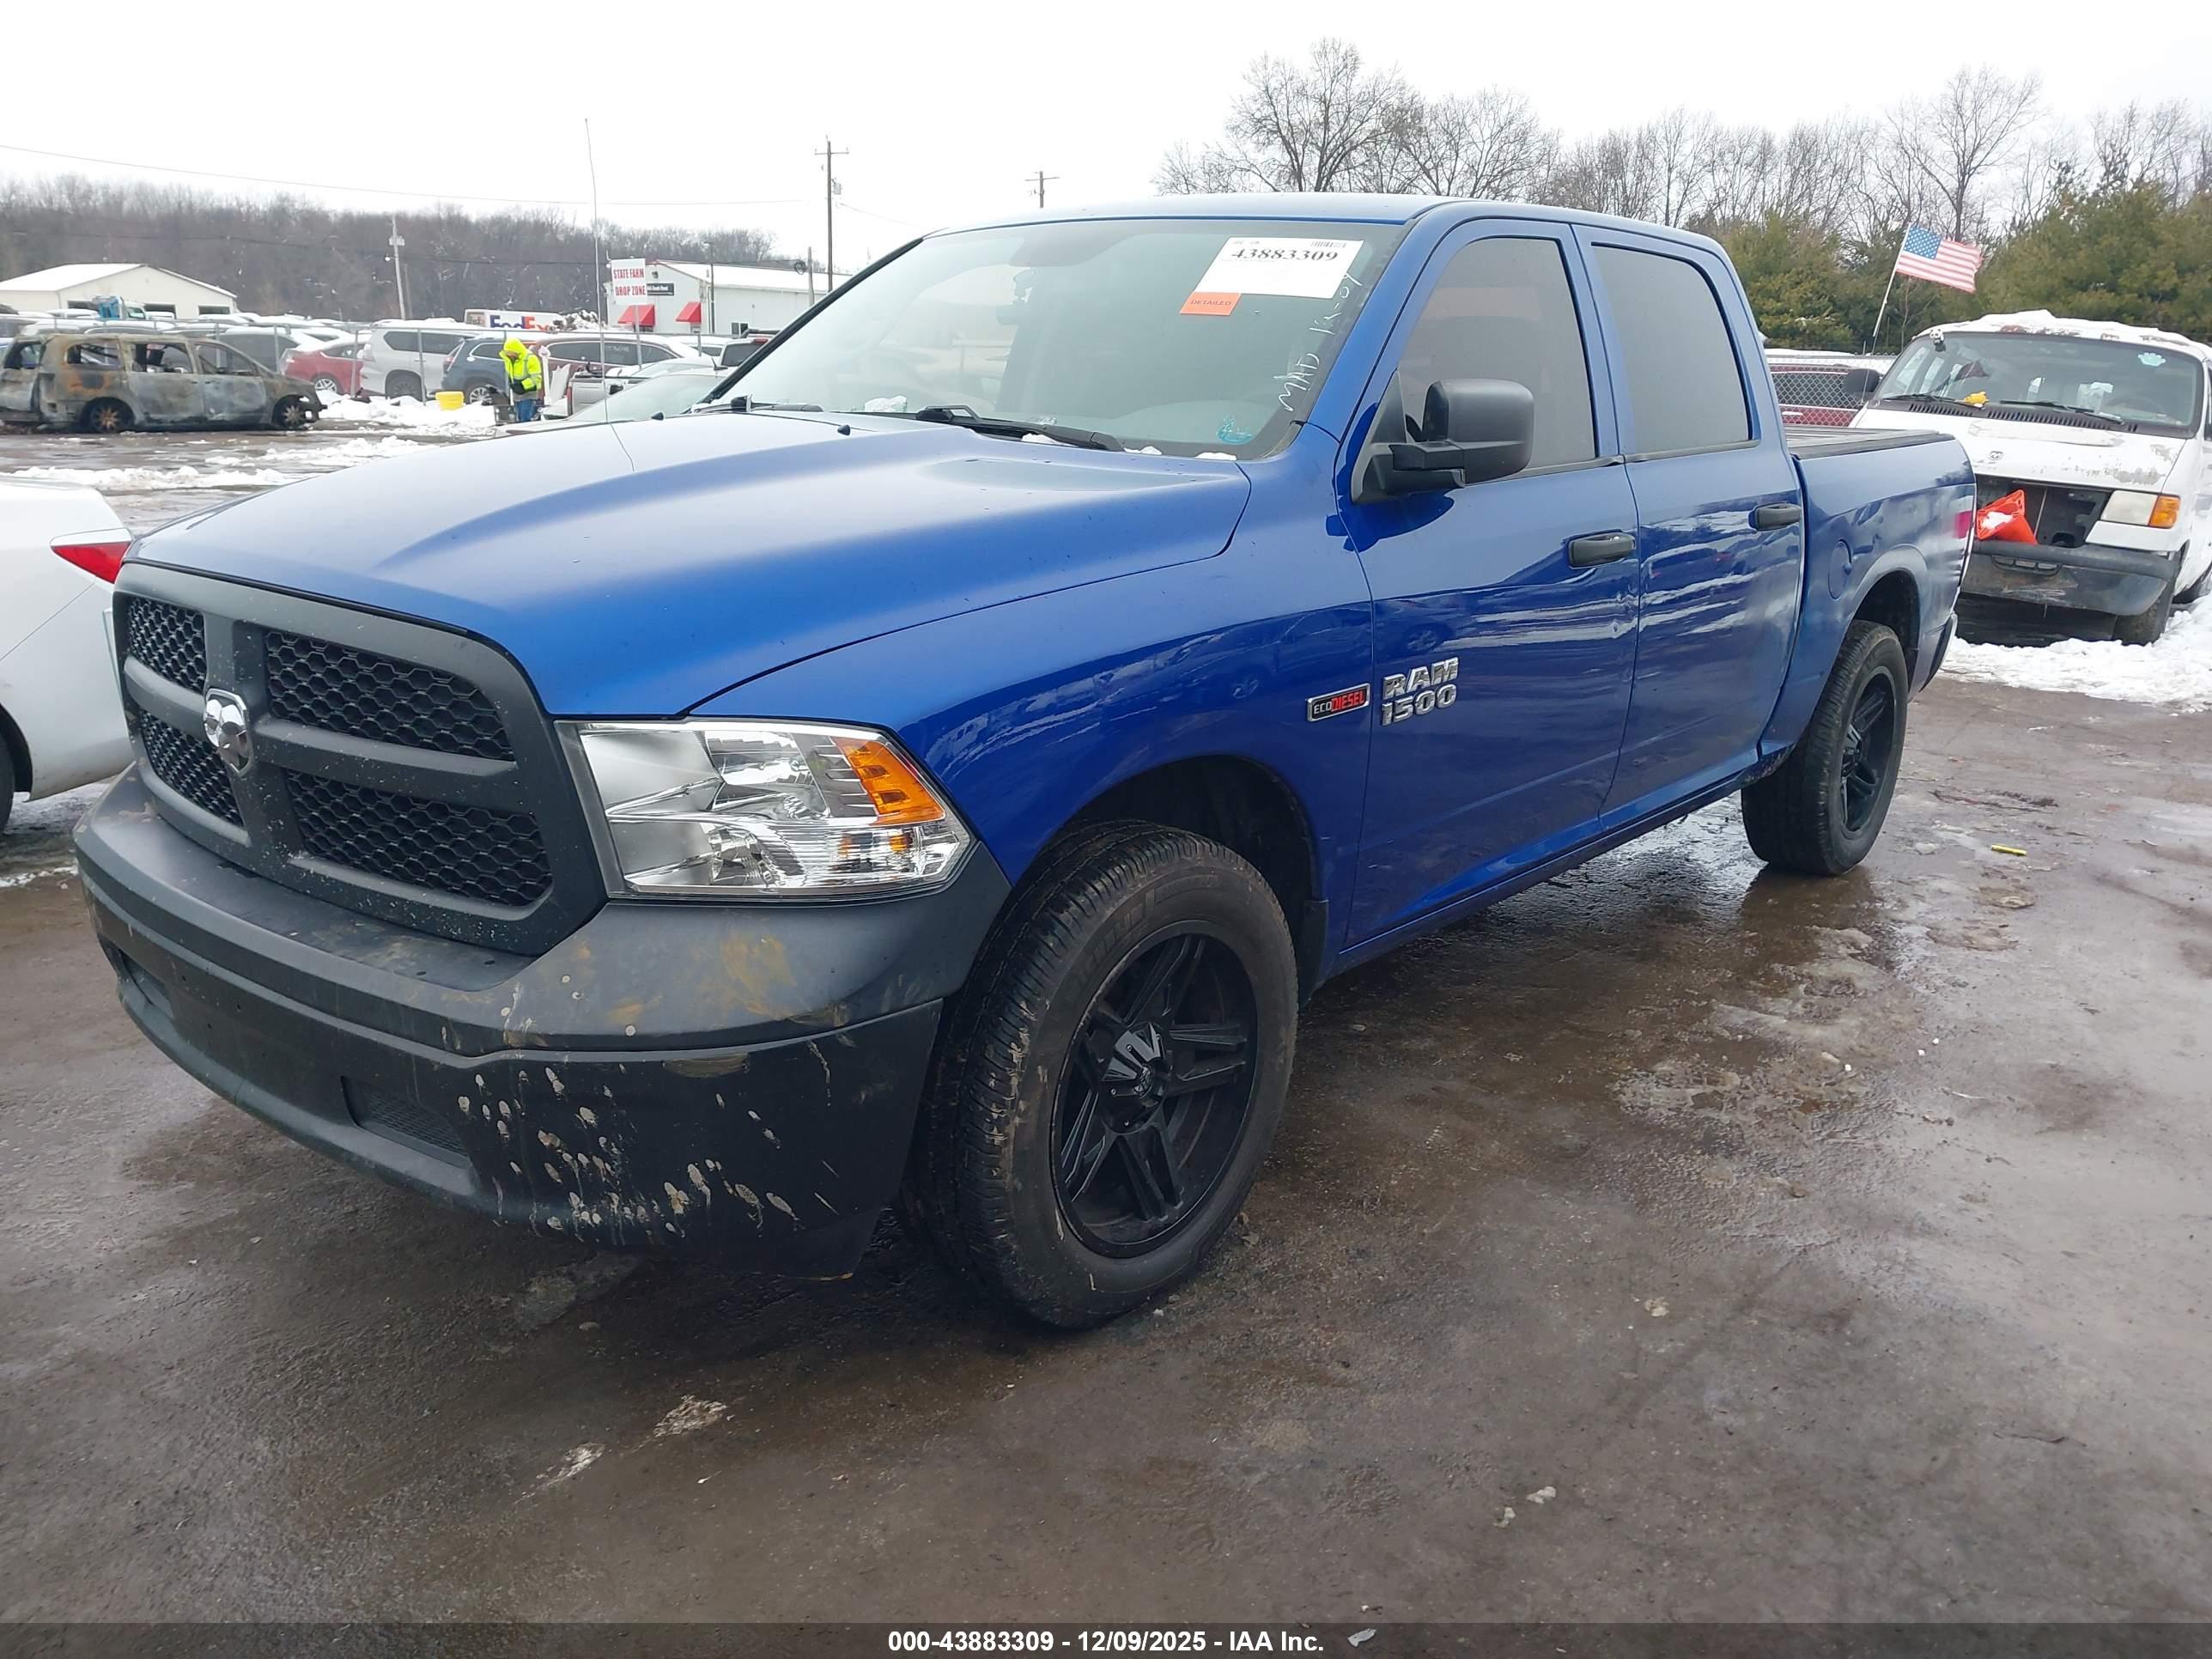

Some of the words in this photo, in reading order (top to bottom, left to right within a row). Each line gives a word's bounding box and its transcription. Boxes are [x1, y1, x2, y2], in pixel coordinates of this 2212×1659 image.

[1231, 248, 1340, 262] 43883309
[613, 269, 629, 279] STATE
[629, 268, 645, 278] FARM
[615, 285, 631, 296] DROP
[631, 285, 647, 295] ZONE
[1382, 656, 1459, 700] RAM
[1381, 684, 1457, 726] 1500
